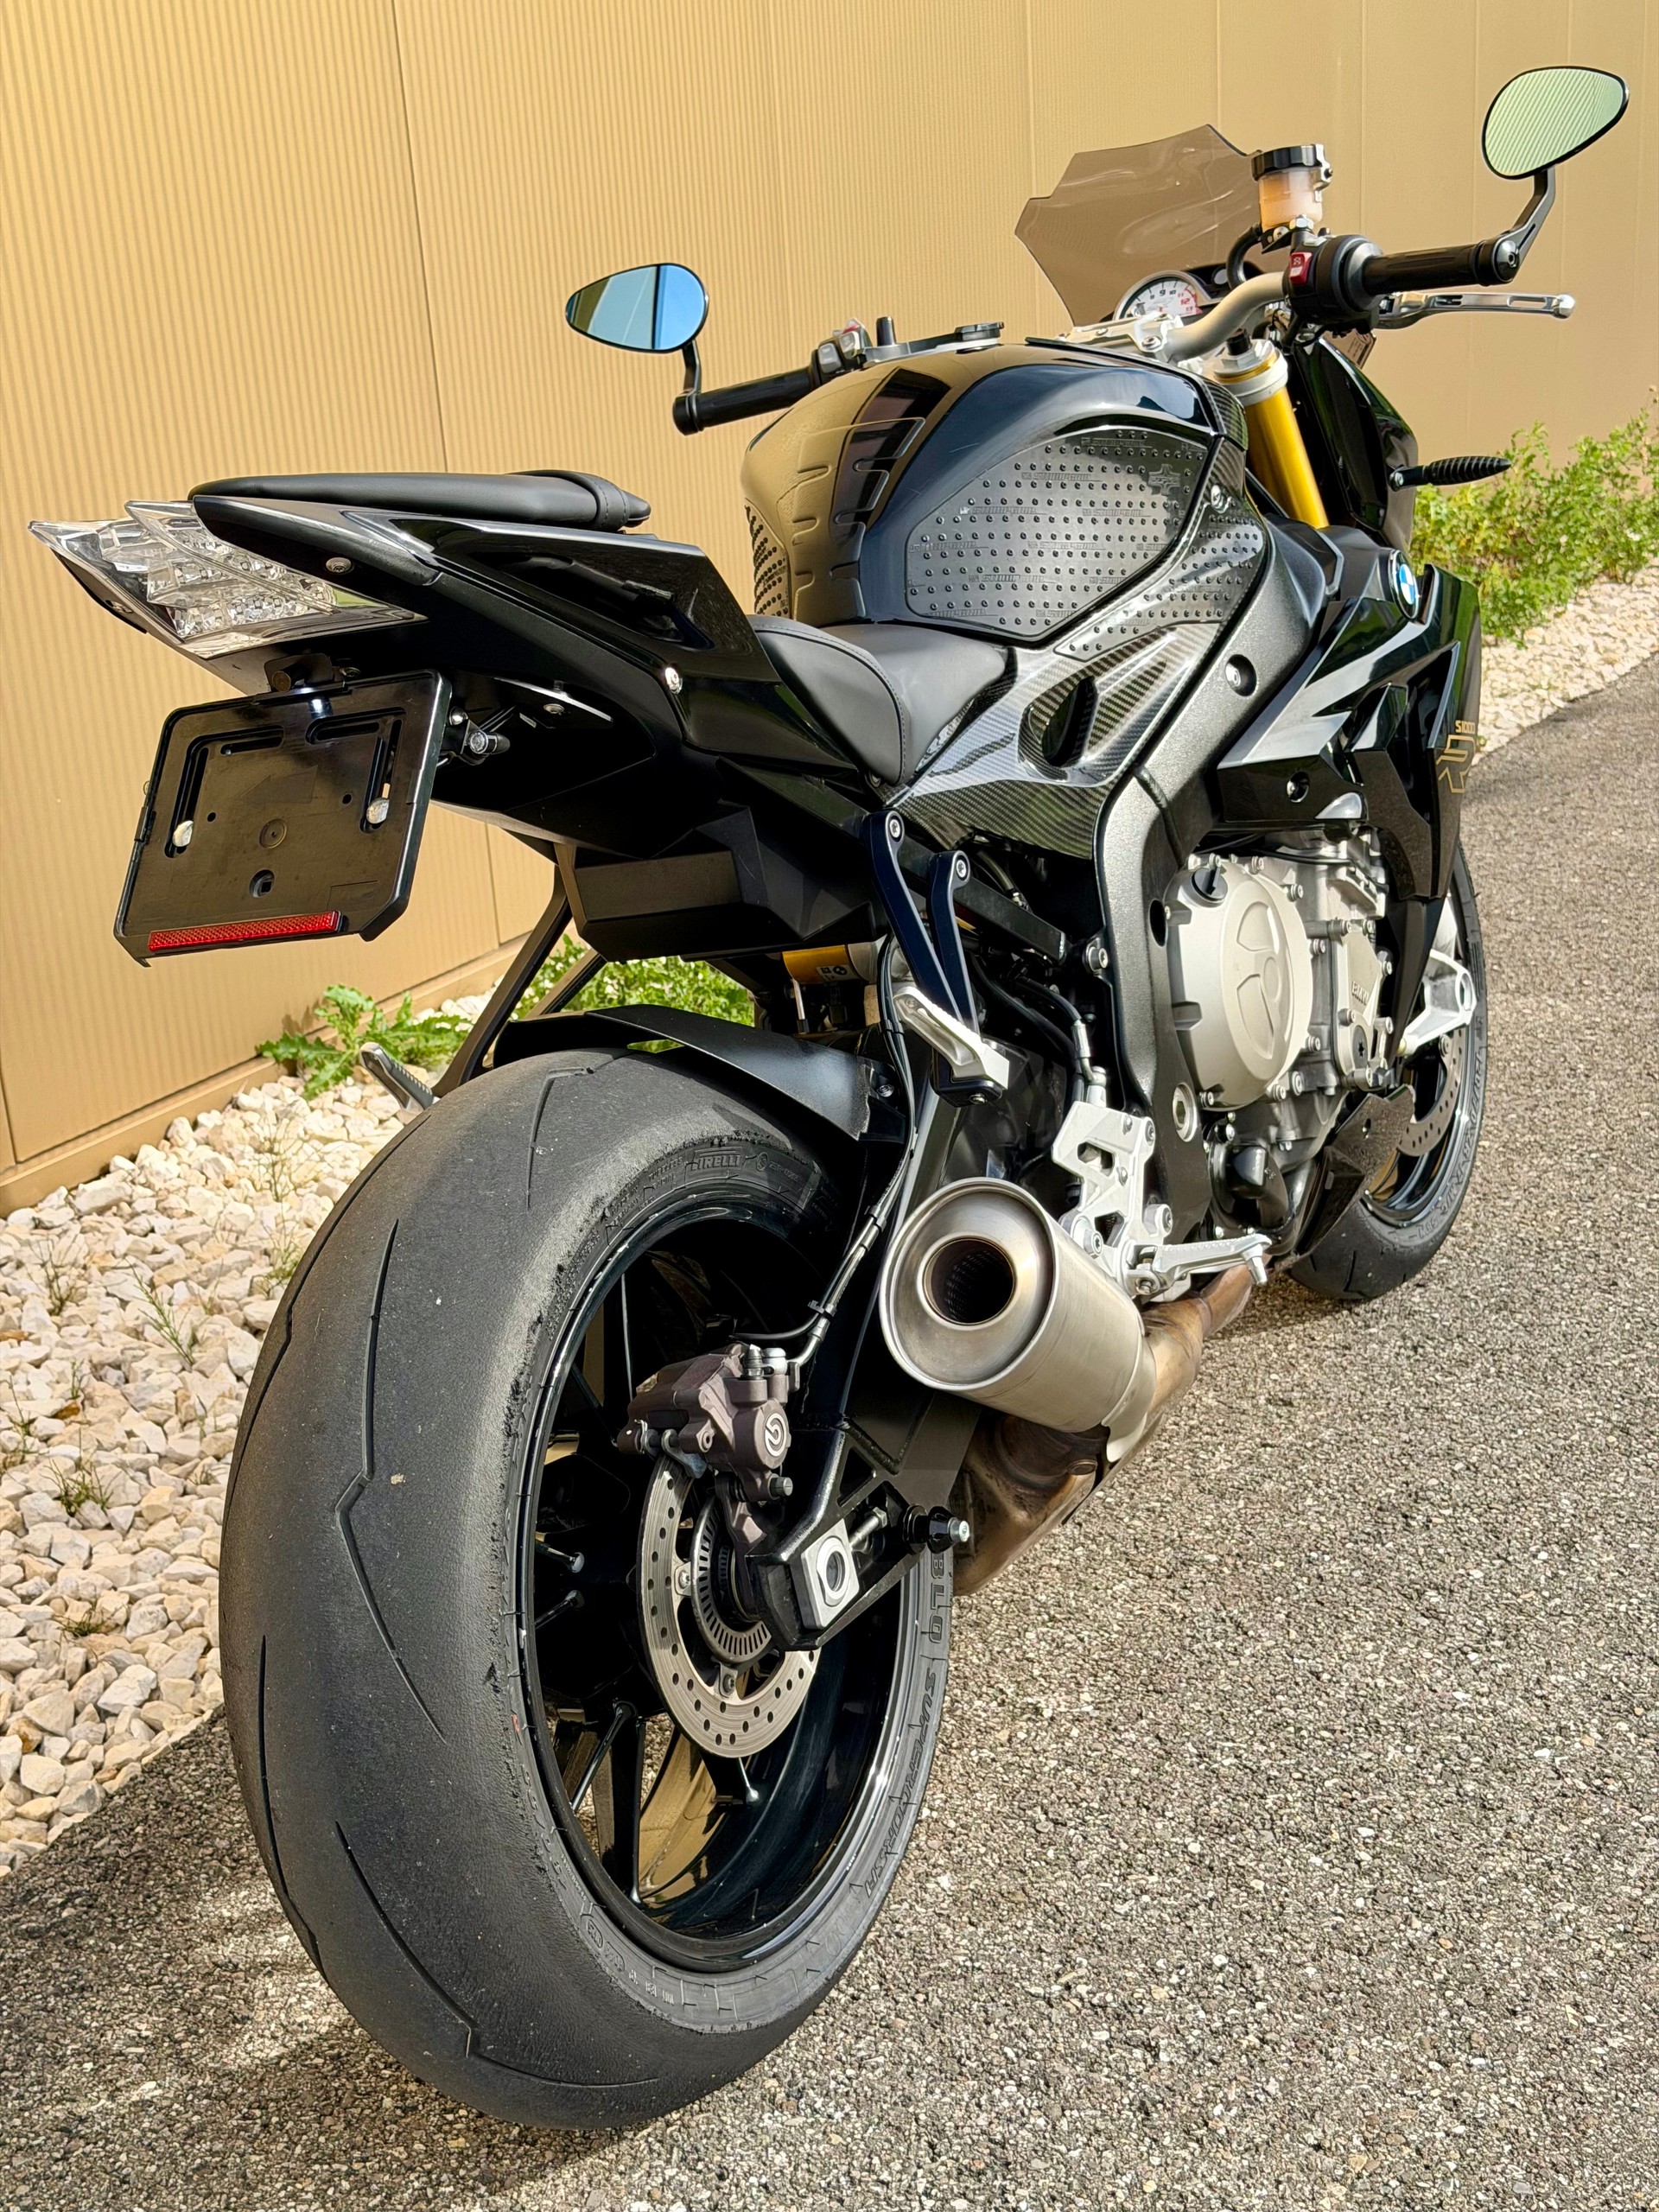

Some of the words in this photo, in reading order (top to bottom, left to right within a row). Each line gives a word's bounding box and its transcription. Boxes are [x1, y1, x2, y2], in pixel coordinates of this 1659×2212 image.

[691, 1147, 741, 1171] PIRELLI
[929, 1550, 945, 1643] BLO
[866, 1667, 938, 1899] SUPERCORSA
